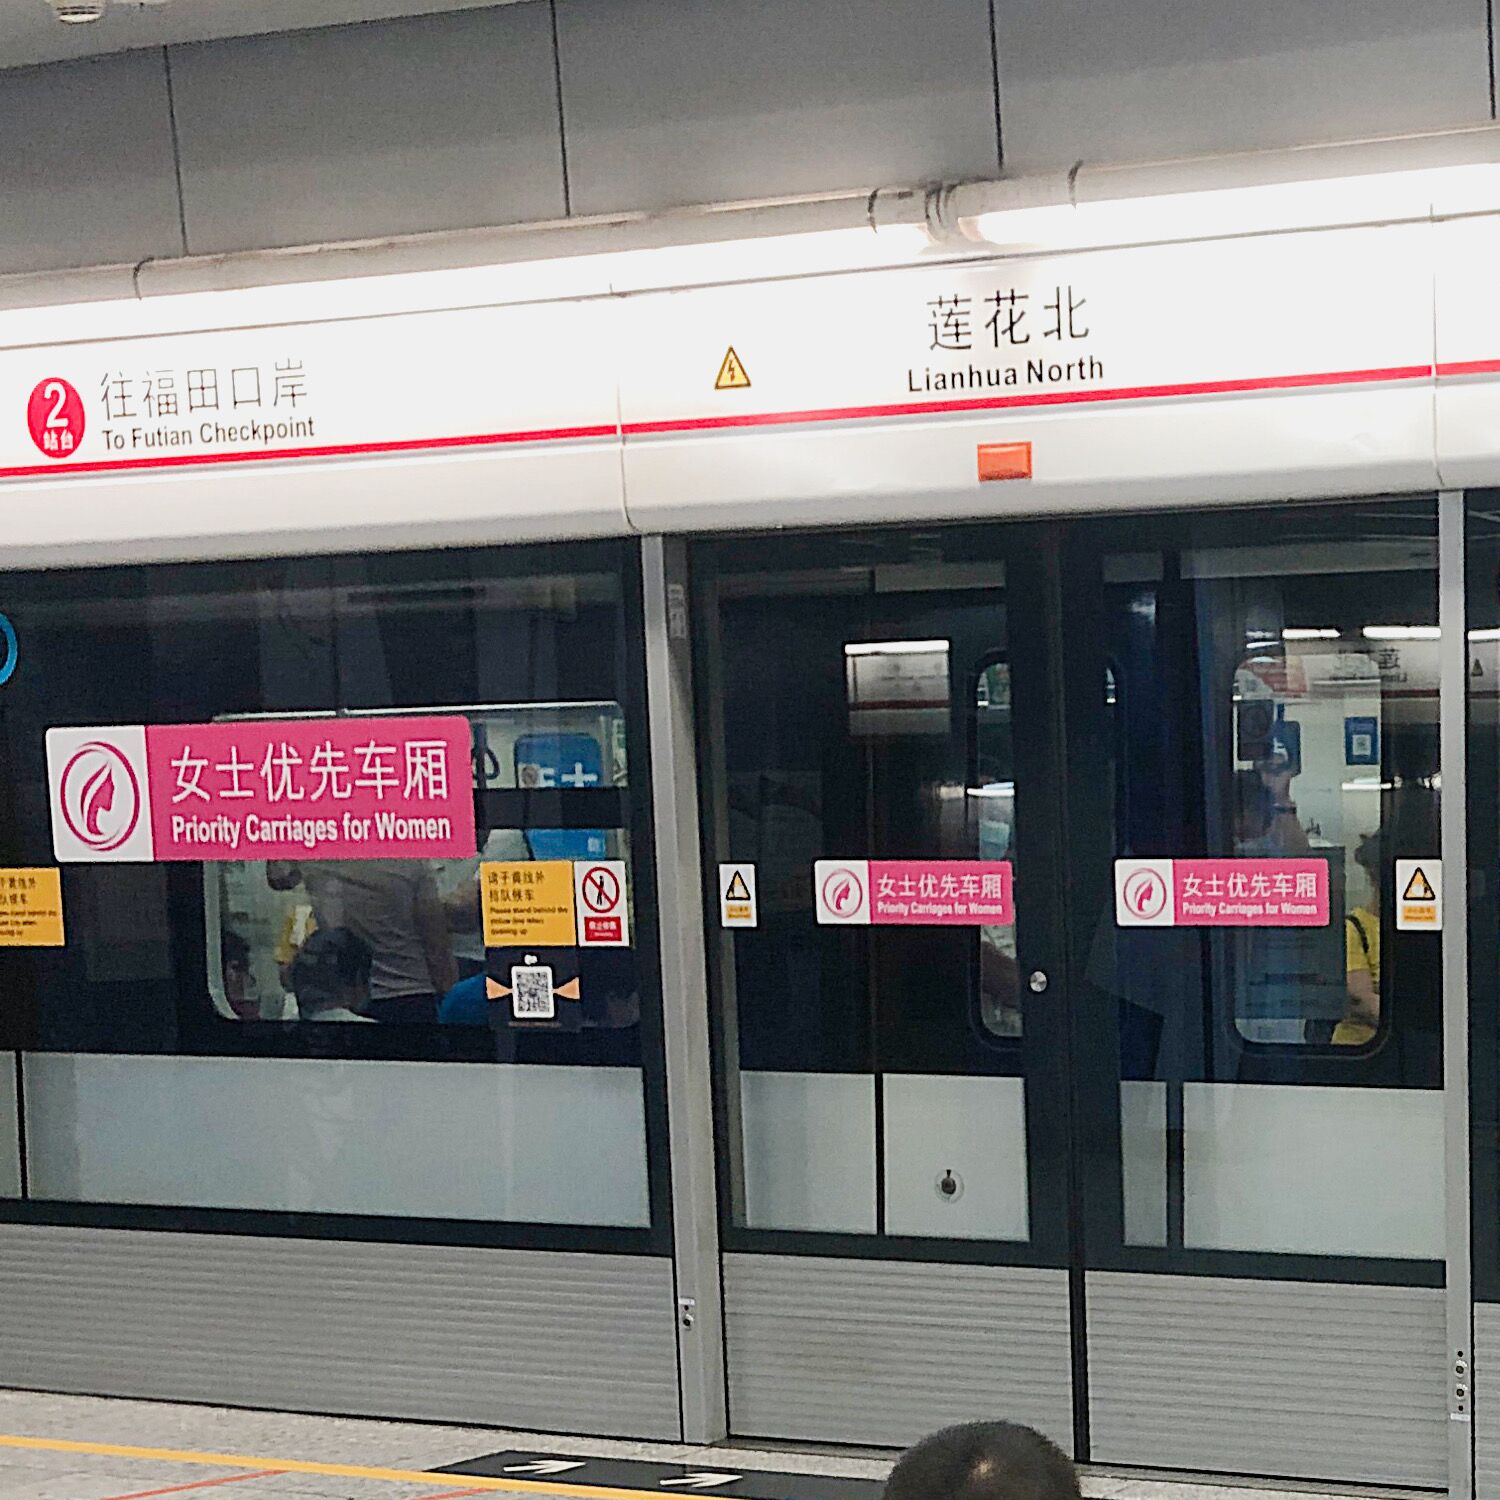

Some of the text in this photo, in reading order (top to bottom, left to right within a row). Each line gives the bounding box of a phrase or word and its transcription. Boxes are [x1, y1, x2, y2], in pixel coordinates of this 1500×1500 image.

[927, 285, 1089, 350] 莲花北
[101, 358, 307, 421] 往福田口岸
[908, 355, 1103, 392] Lianhua North
[44, 382, 68, 428] 2
[102, 416, 315, 450] To Futian Checkpoint
[171, 739, 448, 803] 女士优先车厢
[172, 812, 451, 849] Priority Carriages for Women
[877, 874, 1001, 898] 女士优先车厢
[1183, 872, 1317, 898] 女士优先车厢
